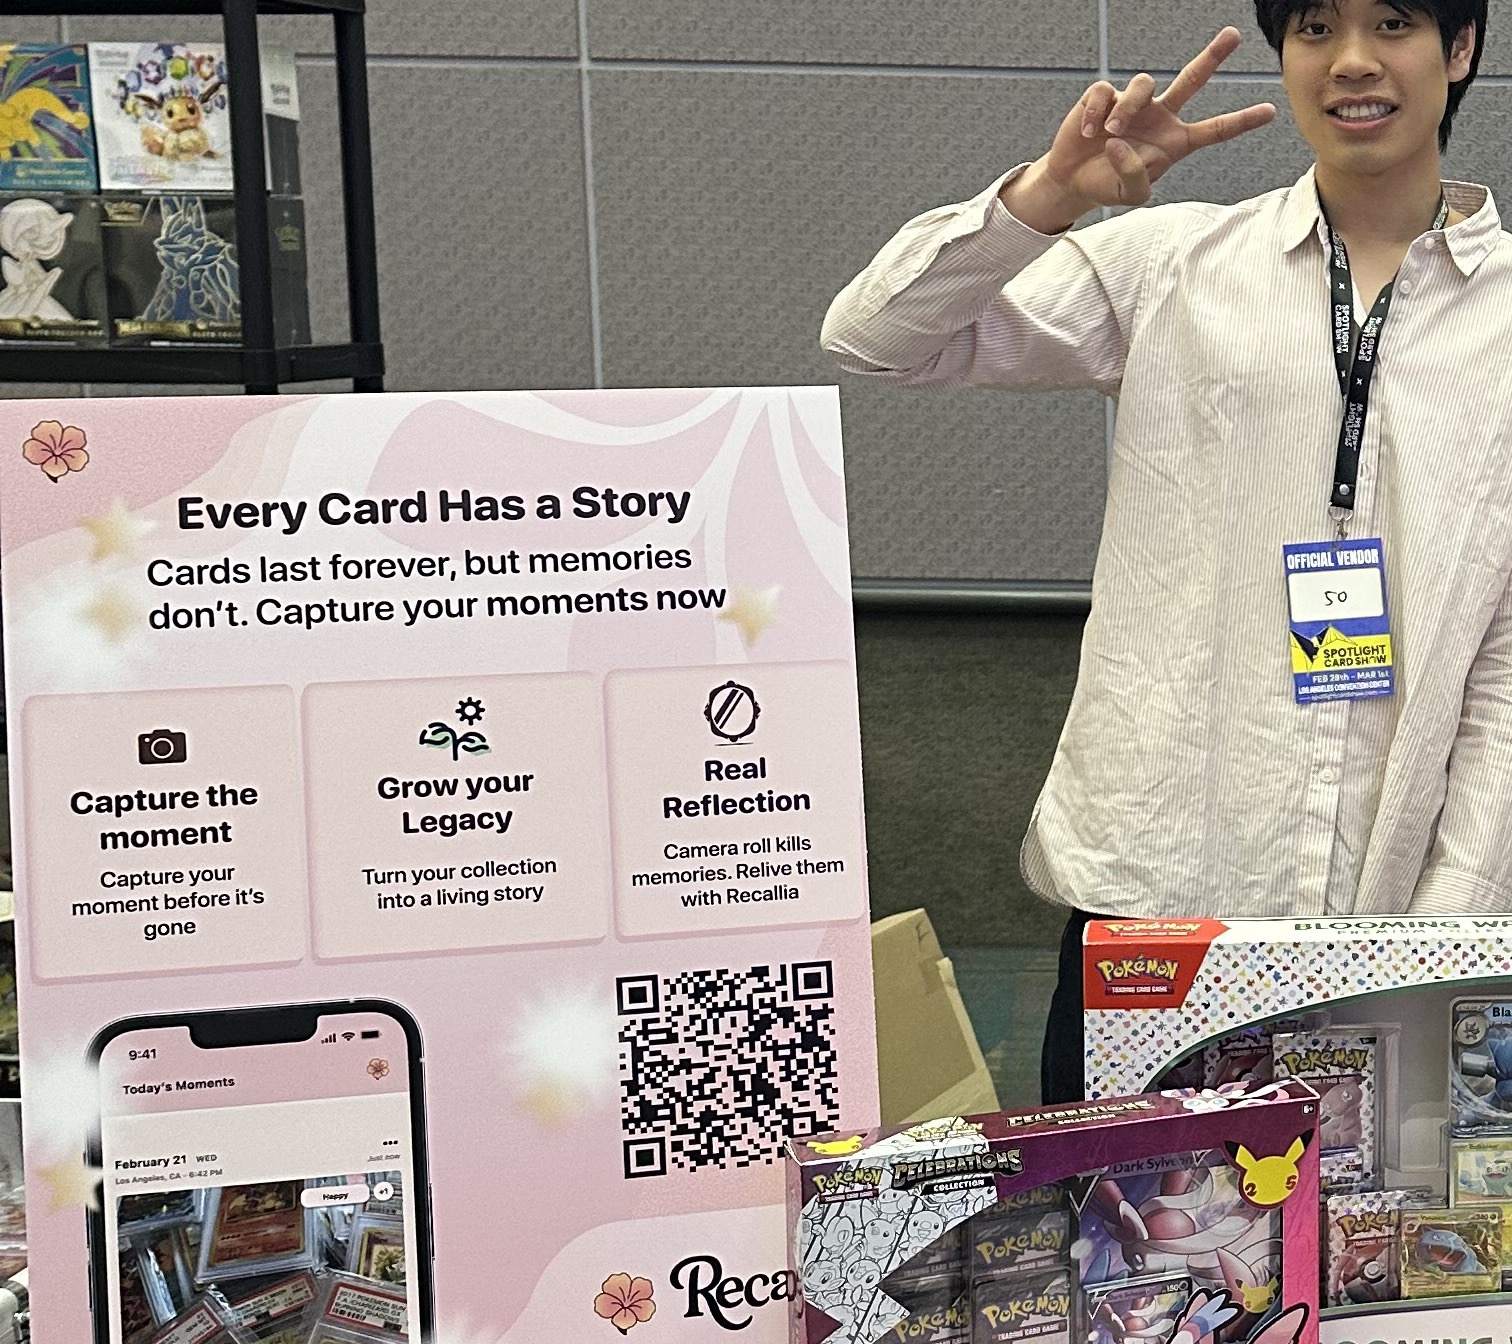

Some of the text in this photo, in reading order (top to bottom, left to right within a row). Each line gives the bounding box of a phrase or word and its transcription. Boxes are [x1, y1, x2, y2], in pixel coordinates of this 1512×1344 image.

[178, 486, 691, 536] Every Card Has a Story
[147, 543, 692, 586] Cards last forever, but memories
[1286, 548, 1380, 570] OFFICIAL VENDOR
[148, 587, 727, 630] don't. Capture your moments now
[1323, 644, 1387, 659] SPOTLIGHT
[1324, 656, 1354, 668] CARD
[704, 757, 767, 782] Real
[377, 774, 534, 800] Grow your
[70, 784, 258, 818] Capture the
[663, 789, 811, 819] Reflection
[100, 821, 232, 850] moment
[402, 810, 513, 837] Legacy
[664, 835, 812, 860] Camera roll kills
[100, 867, 235, 890] Capture your
[362, 858, 557, 886] Turn your collection
[632, 858, 845, 887] memories. Relive them
[72, 888, 265, 916] moment before it's
[377, 885, 545, 909] into a living story
[680, 884, 800, 907] with Recallia
[143, 921, 197, 941] gone
[1294, 920, 1461, 931] BLOOMING
[129, 1048, 157, 1061] 9:41
[122, 1076, 236, 1096] Today's Moments
[114, 1154, 218, 1172] February 21 WED
[892, 1148, 1025, 1189] CELEBRATIONS
[1113, 1159, 1144, 1174] Dark
[115, 1176, 130, 1186] Los
[933, 1178, 985, 1193] COLLECTION
[669, 1255, 796, 1331] Reca
